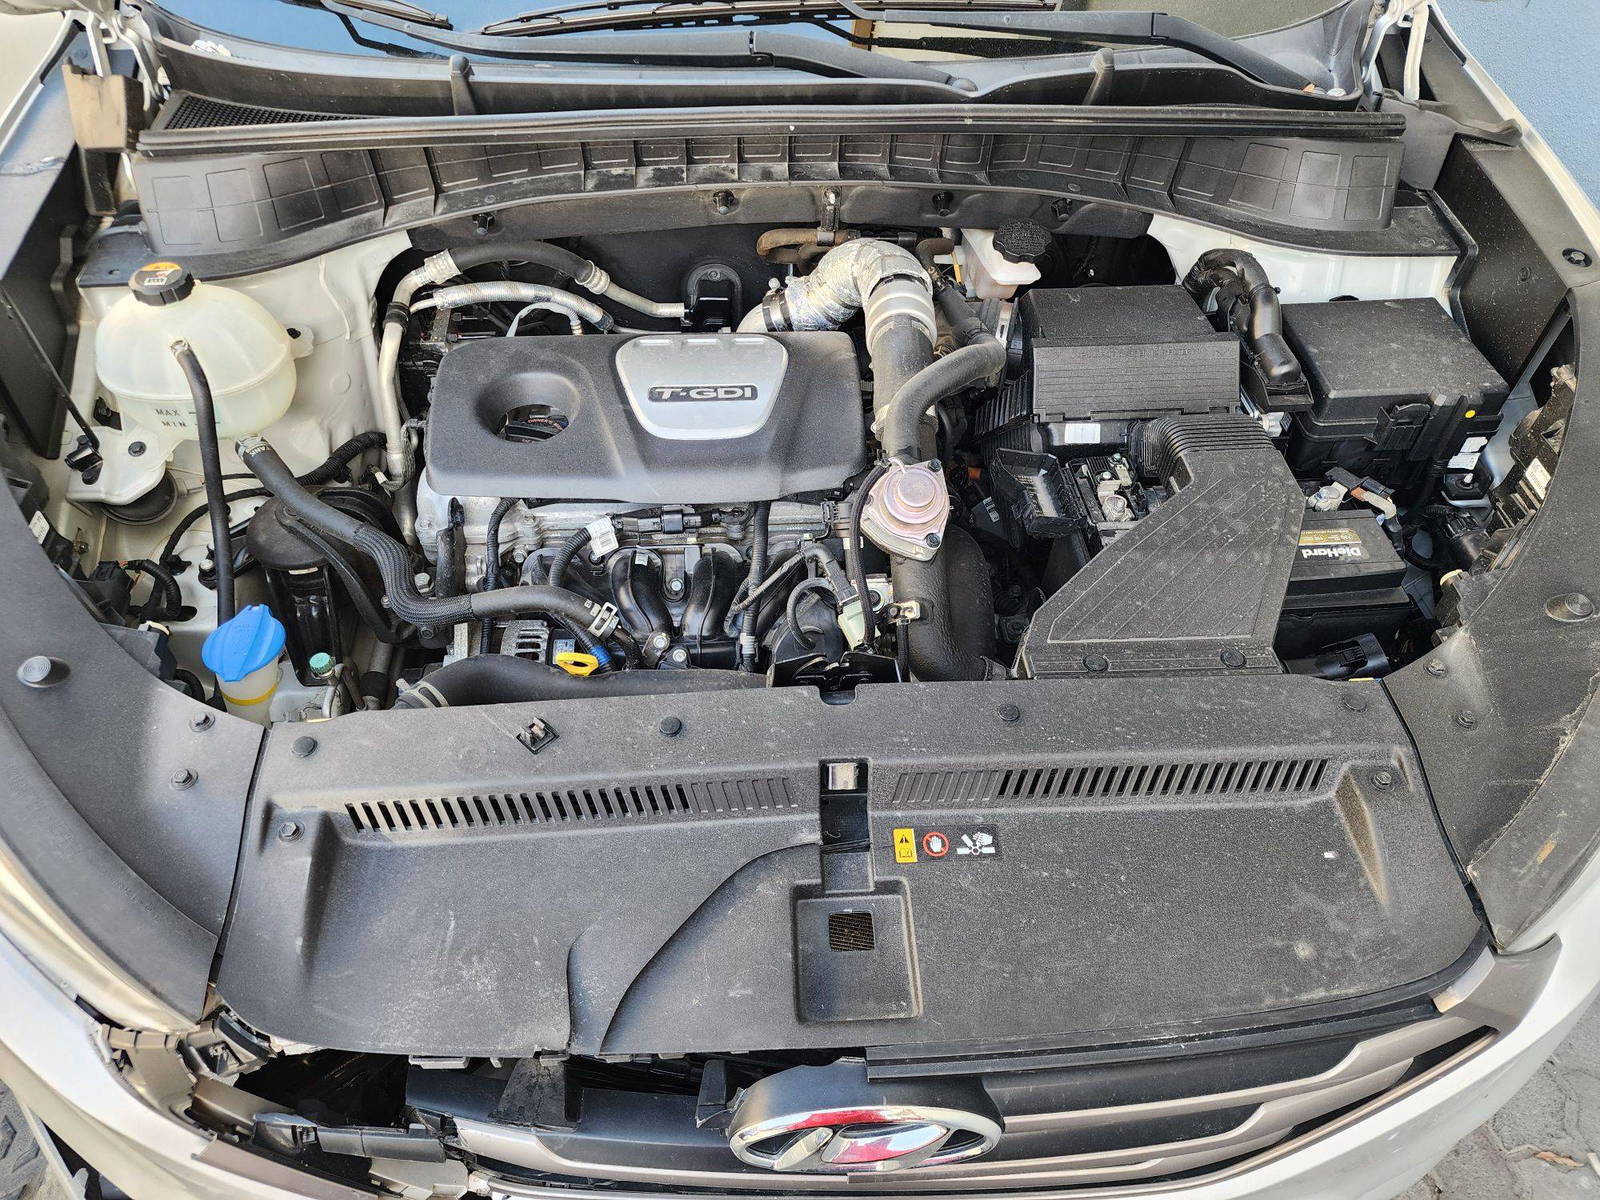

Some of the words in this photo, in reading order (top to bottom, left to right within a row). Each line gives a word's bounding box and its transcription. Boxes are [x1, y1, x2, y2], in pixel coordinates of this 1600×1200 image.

[155, 408, 181, 417] MAX
[161, 420, 187, 428] MIN
[1301, 546, 1362, 559] DieHard
